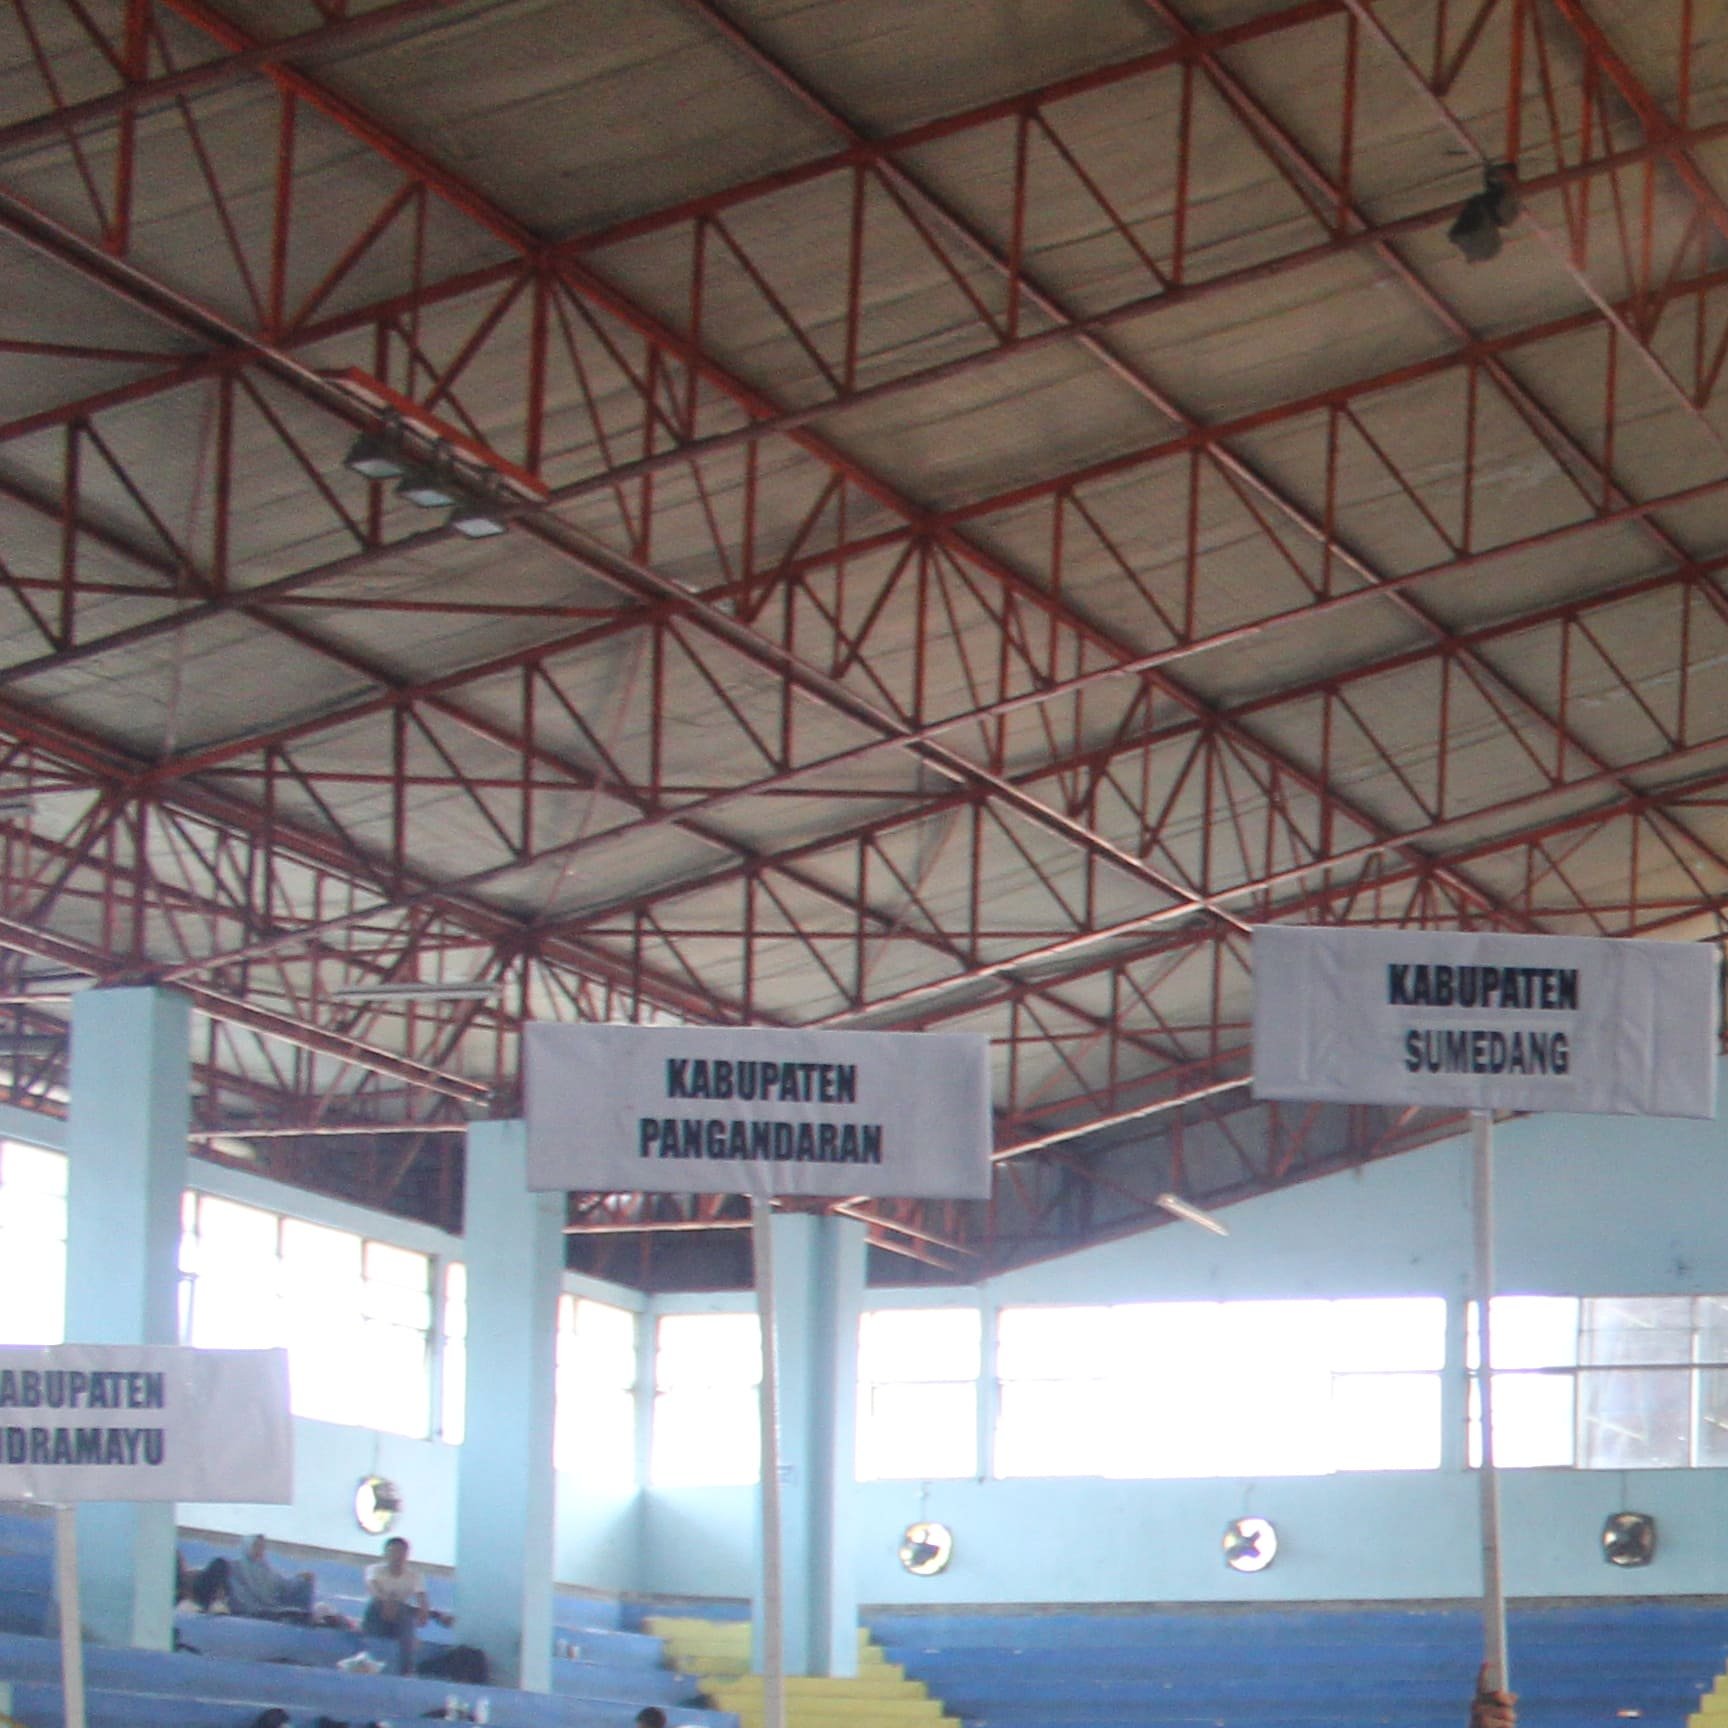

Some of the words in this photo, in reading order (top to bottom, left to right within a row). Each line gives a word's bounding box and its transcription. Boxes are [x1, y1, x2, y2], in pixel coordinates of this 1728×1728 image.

[1388, 963, 1579, 1011] KABUPATEN
[1404, 1028, 1570, 1076] SUMEDANG
[666, 1057, 857, 1104] KABUPATEN
[639, 1117, 883, 1165] PANGANDARAN
[0, 1369, 165, 1409] ABUPATEN
[0, 1426, 165, 1466] DRAMAYU
